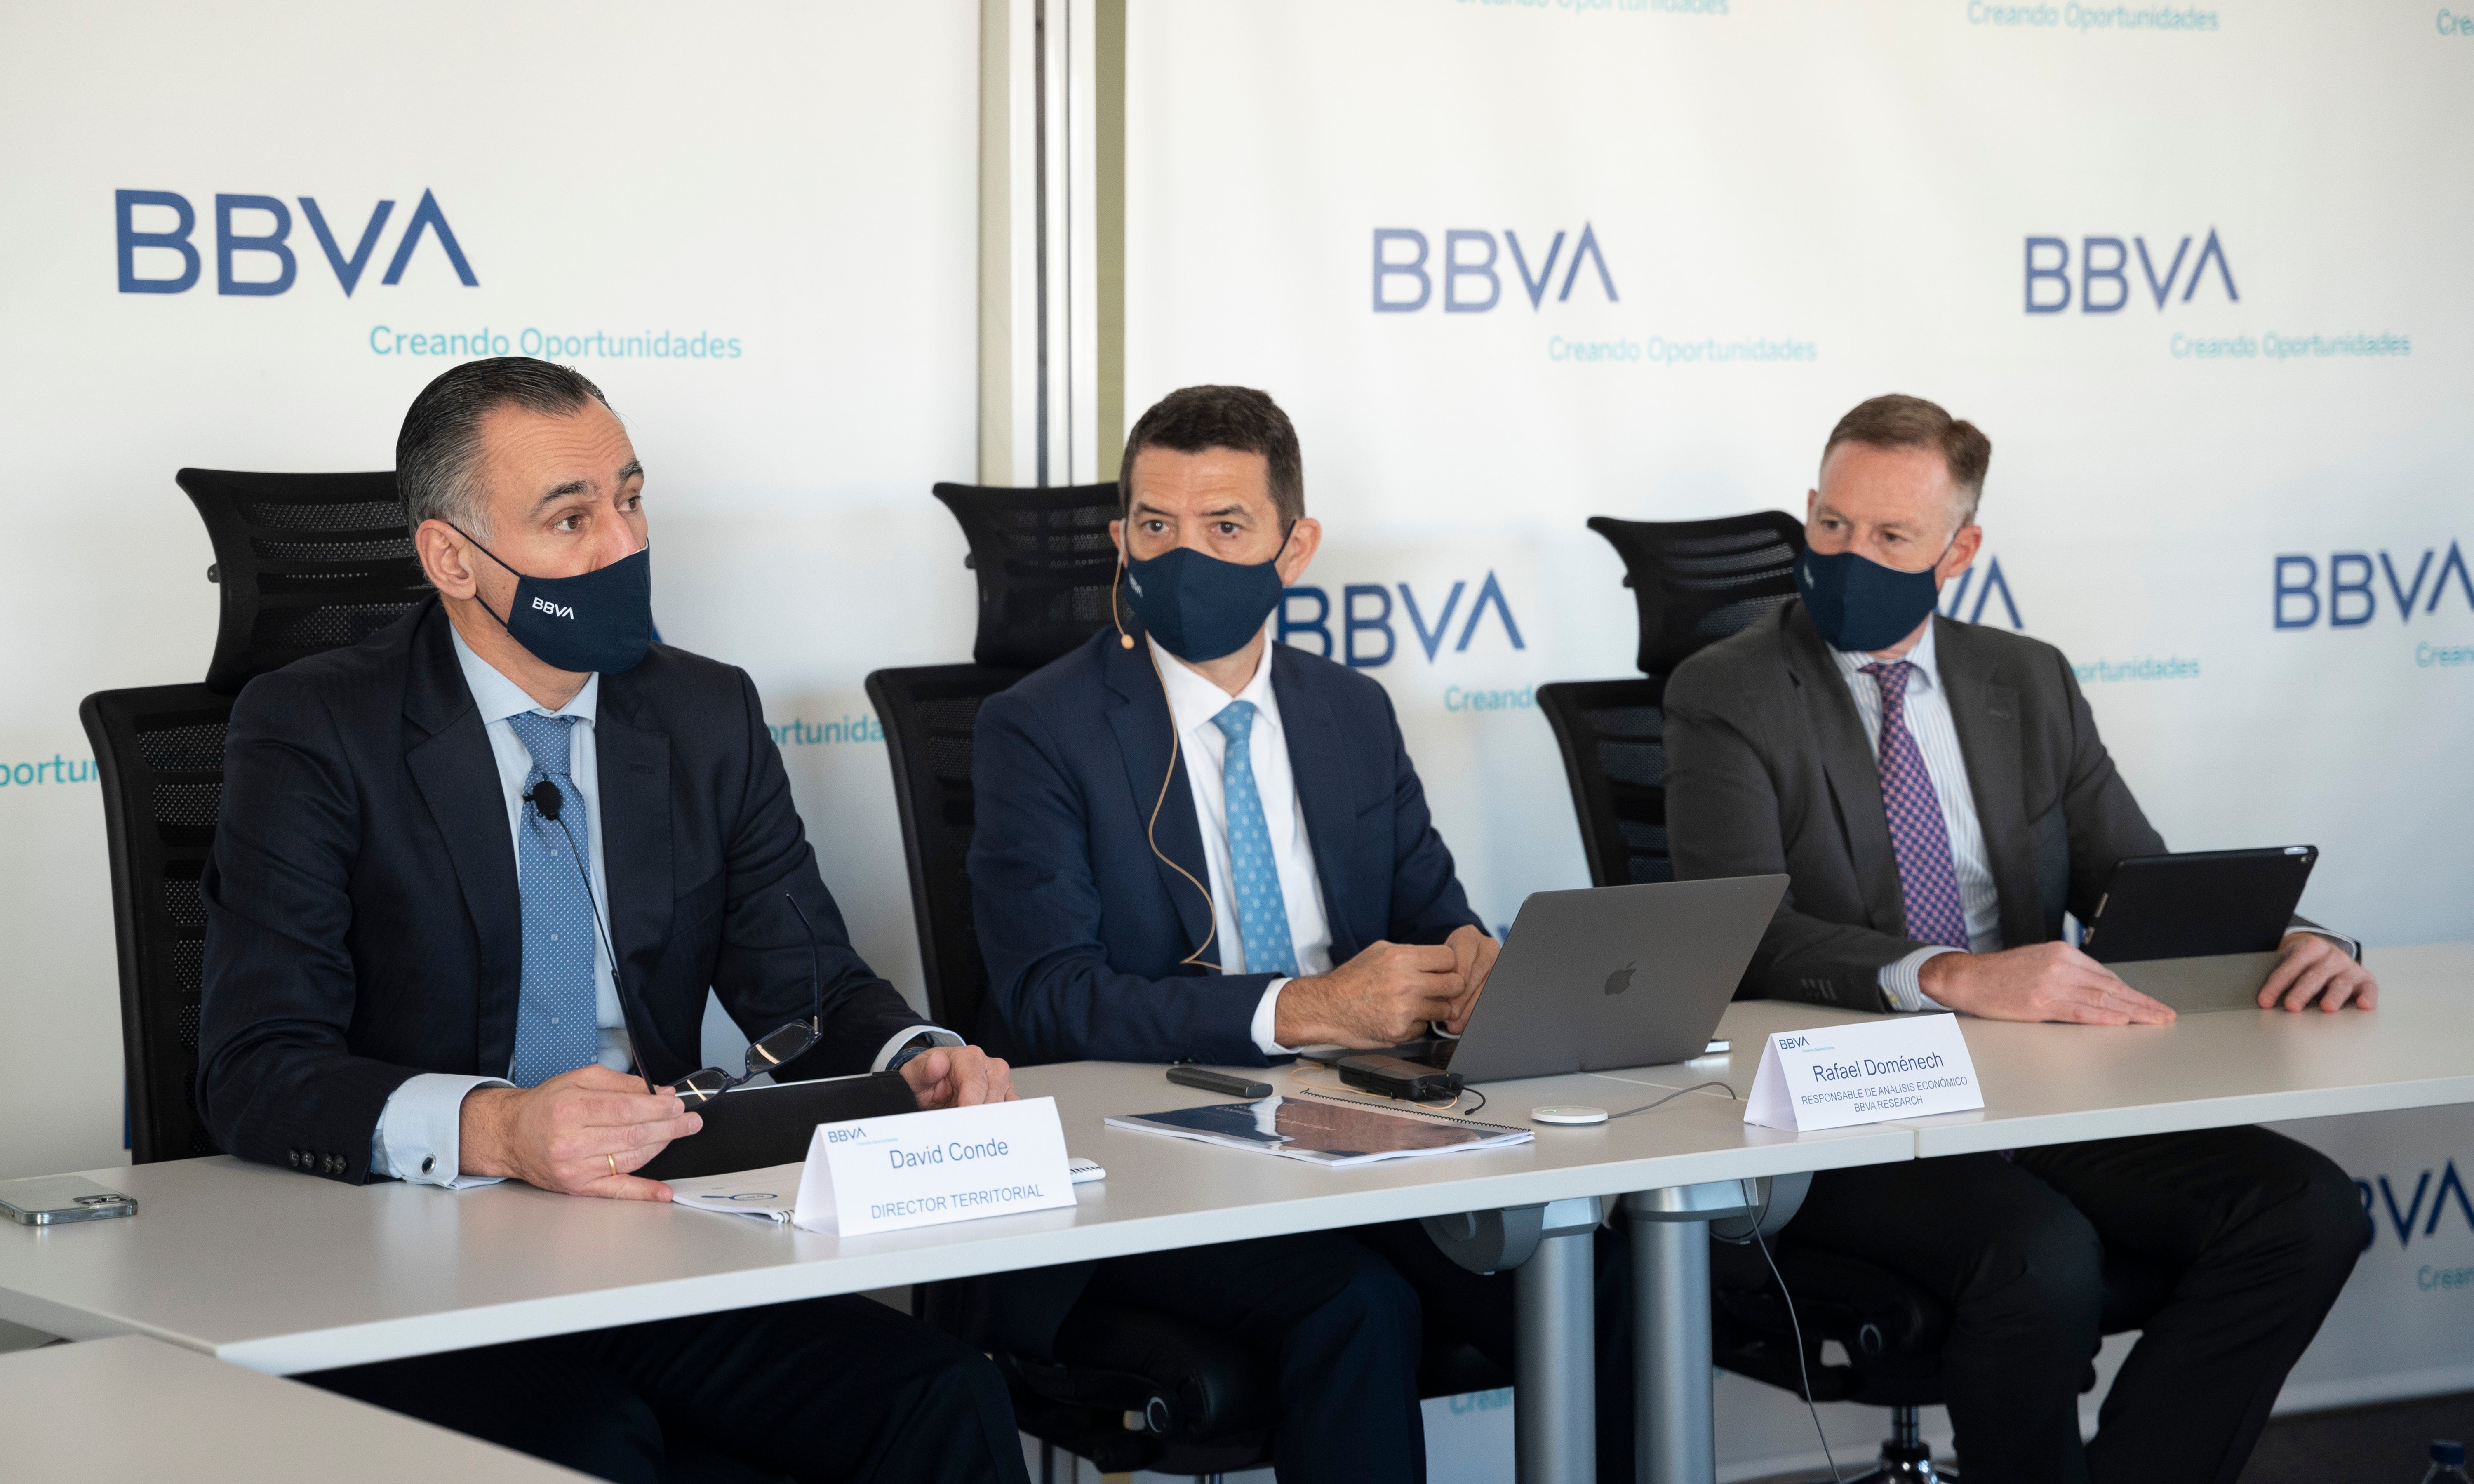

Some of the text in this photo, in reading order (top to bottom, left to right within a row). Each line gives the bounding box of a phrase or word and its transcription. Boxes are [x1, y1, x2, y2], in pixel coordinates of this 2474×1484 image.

[2065, 1, 2220, 32] Oportunidades
[115, 188, 480, 297] BBVA
[1373, 222, 1619, 313] BBVA
[2024, 227, 2240, 315] BBVA
[370, 325, 742, 362] Creando Oportunidades
[1549, 335, 1818, 367] Creando Oportunidades
[2170, 331, 2411, 362] Creando Oportunidades
[532, 597, 574, 620] BBVA
[1275, 569, 1525, 668] BBVA
[1444, 685, 1539, 712] Creand
[1779, 1035, 1810, 1049] BBVA
[1813, 1051, 1944, 1082] Rafael Doménech
[1801, 1076, 1968, 1105] RESPONSABLE DE ANÁLISIS ECONÓMICO
[1854, 1096, 1923, 1112] BBVA RESEARCH
[828, 1127, 867, 1143] BBVA
[889, 1138, 1009, 1169] David Conde
[871, 1185, 1044, 1219] DIRECTOR TERRITORIAL
